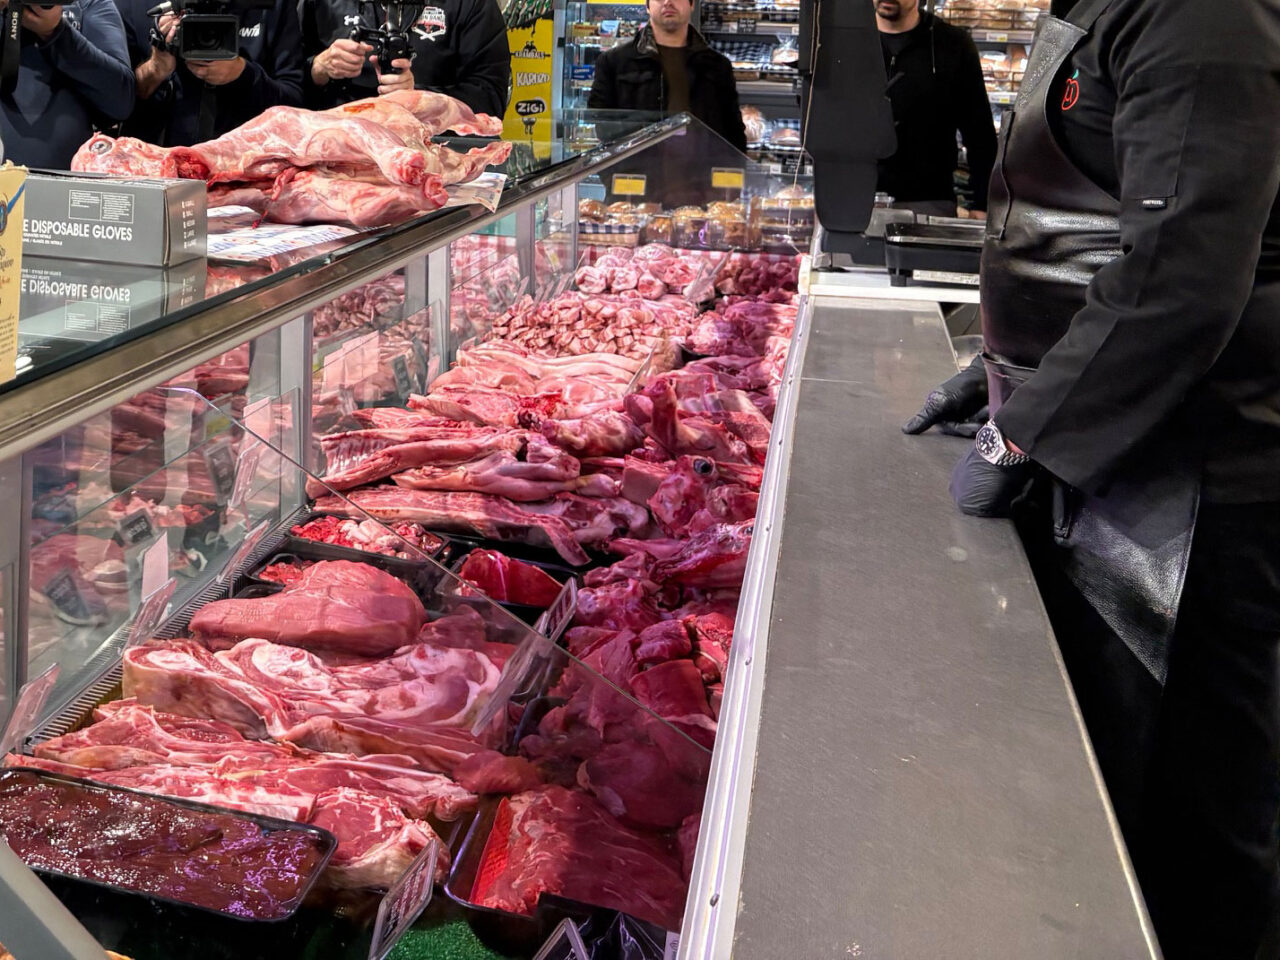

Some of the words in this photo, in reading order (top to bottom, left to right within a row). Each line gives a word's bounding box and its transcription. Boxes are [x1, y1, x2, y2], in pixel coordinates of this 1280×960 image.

[10, 11, 19, 40] SONY
[31, 220, 90, 238] DISPOSABLE
[92, 224, 133, 241] GLOVES
